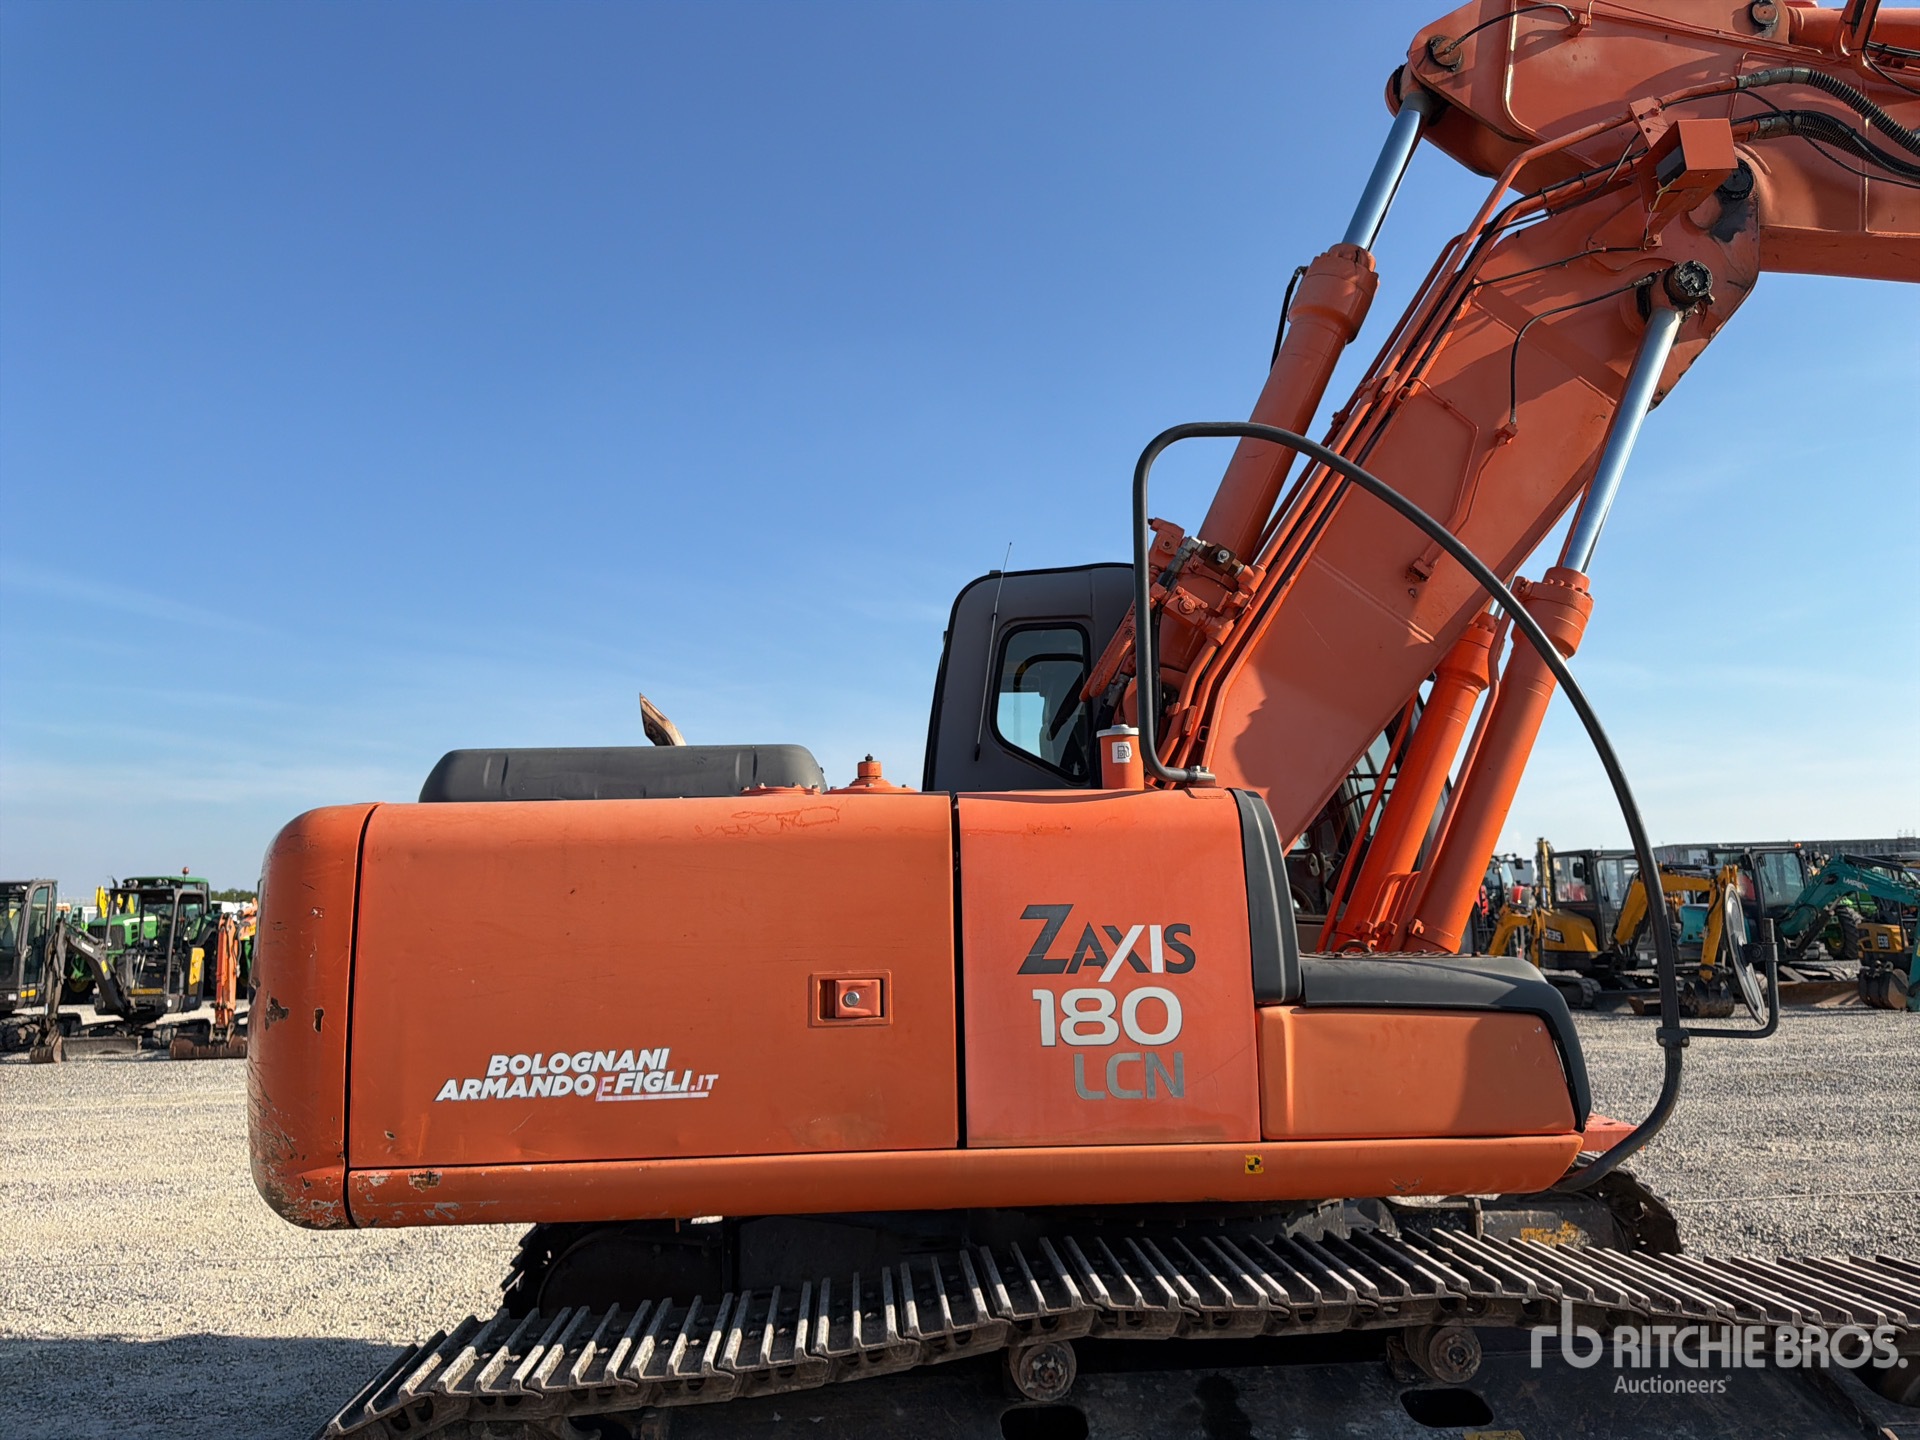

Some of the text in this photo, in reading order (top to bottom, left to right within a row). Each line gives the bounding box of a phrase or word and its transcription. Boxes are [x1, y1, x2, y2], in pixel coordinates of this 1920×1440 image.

[1032, 986, 1183, 1047] 180
[485, 1048, 670, 1077] BOLOGNANI
[1073, 1052, 1184, 1100] LCN
